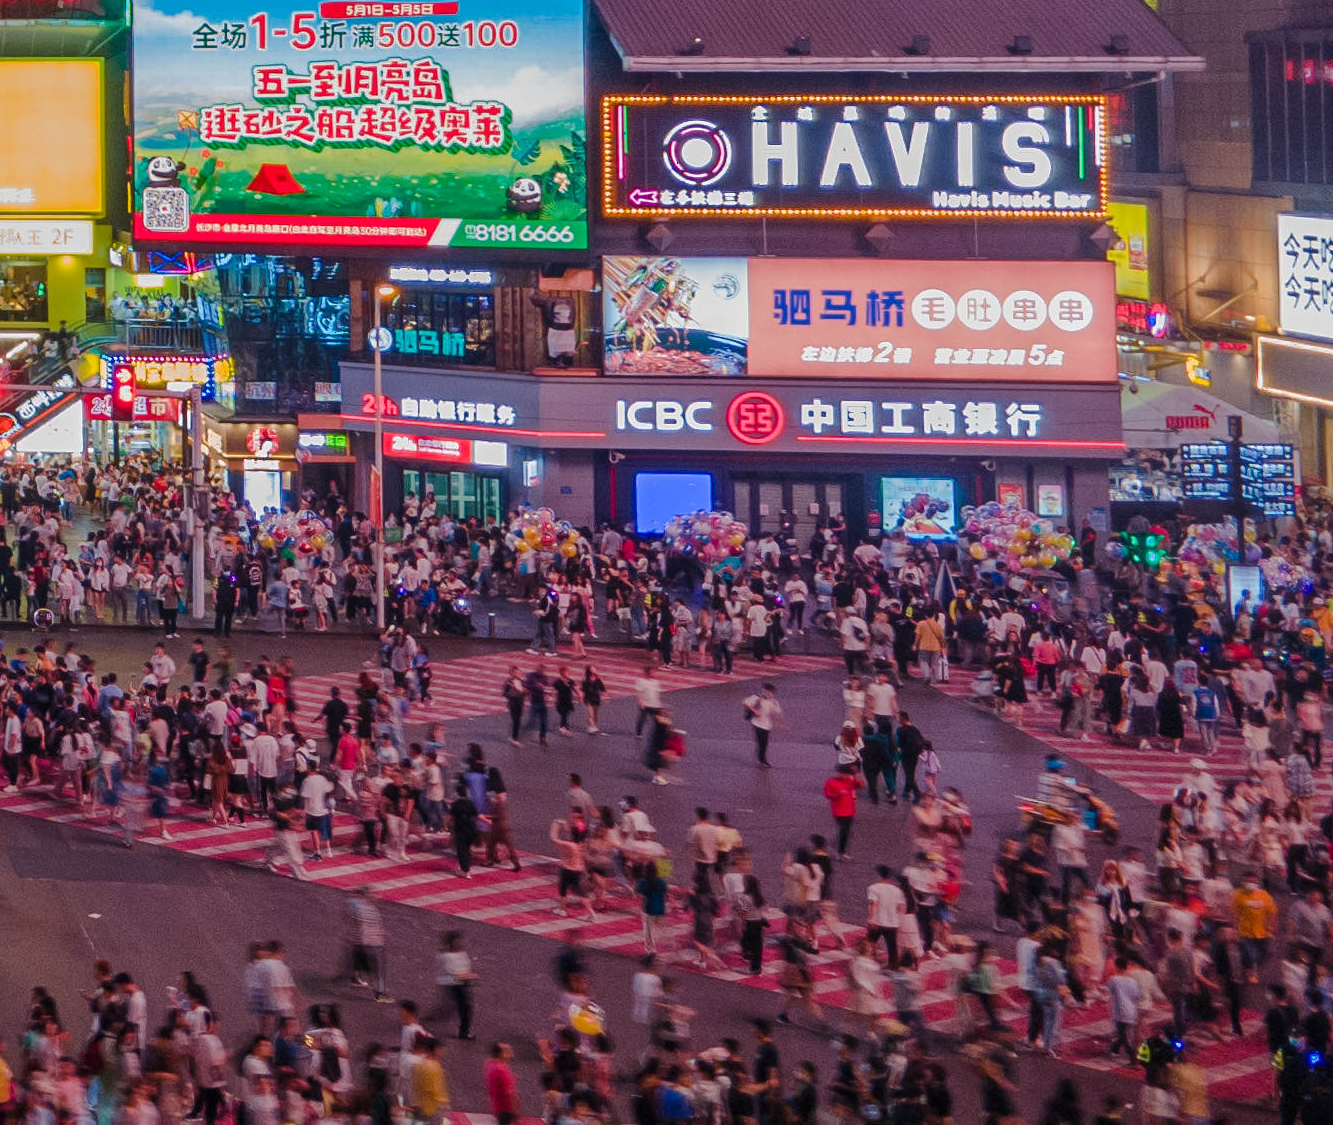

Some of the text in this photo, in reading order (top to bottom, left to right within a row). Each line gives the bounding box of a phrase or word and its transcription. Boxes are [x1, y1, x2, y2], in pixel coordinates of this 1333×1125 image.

[253, 59, 449, 103] 五一到月亮岛
[200, 103, 506, 149] 逛砂之船超级奥莱
[751, 121, 1052, 188] HAVIS
[933, 190, 1091, 209] Havis Music Bar
[616, 399, 1043, 437] ICBC 中国工商银行
